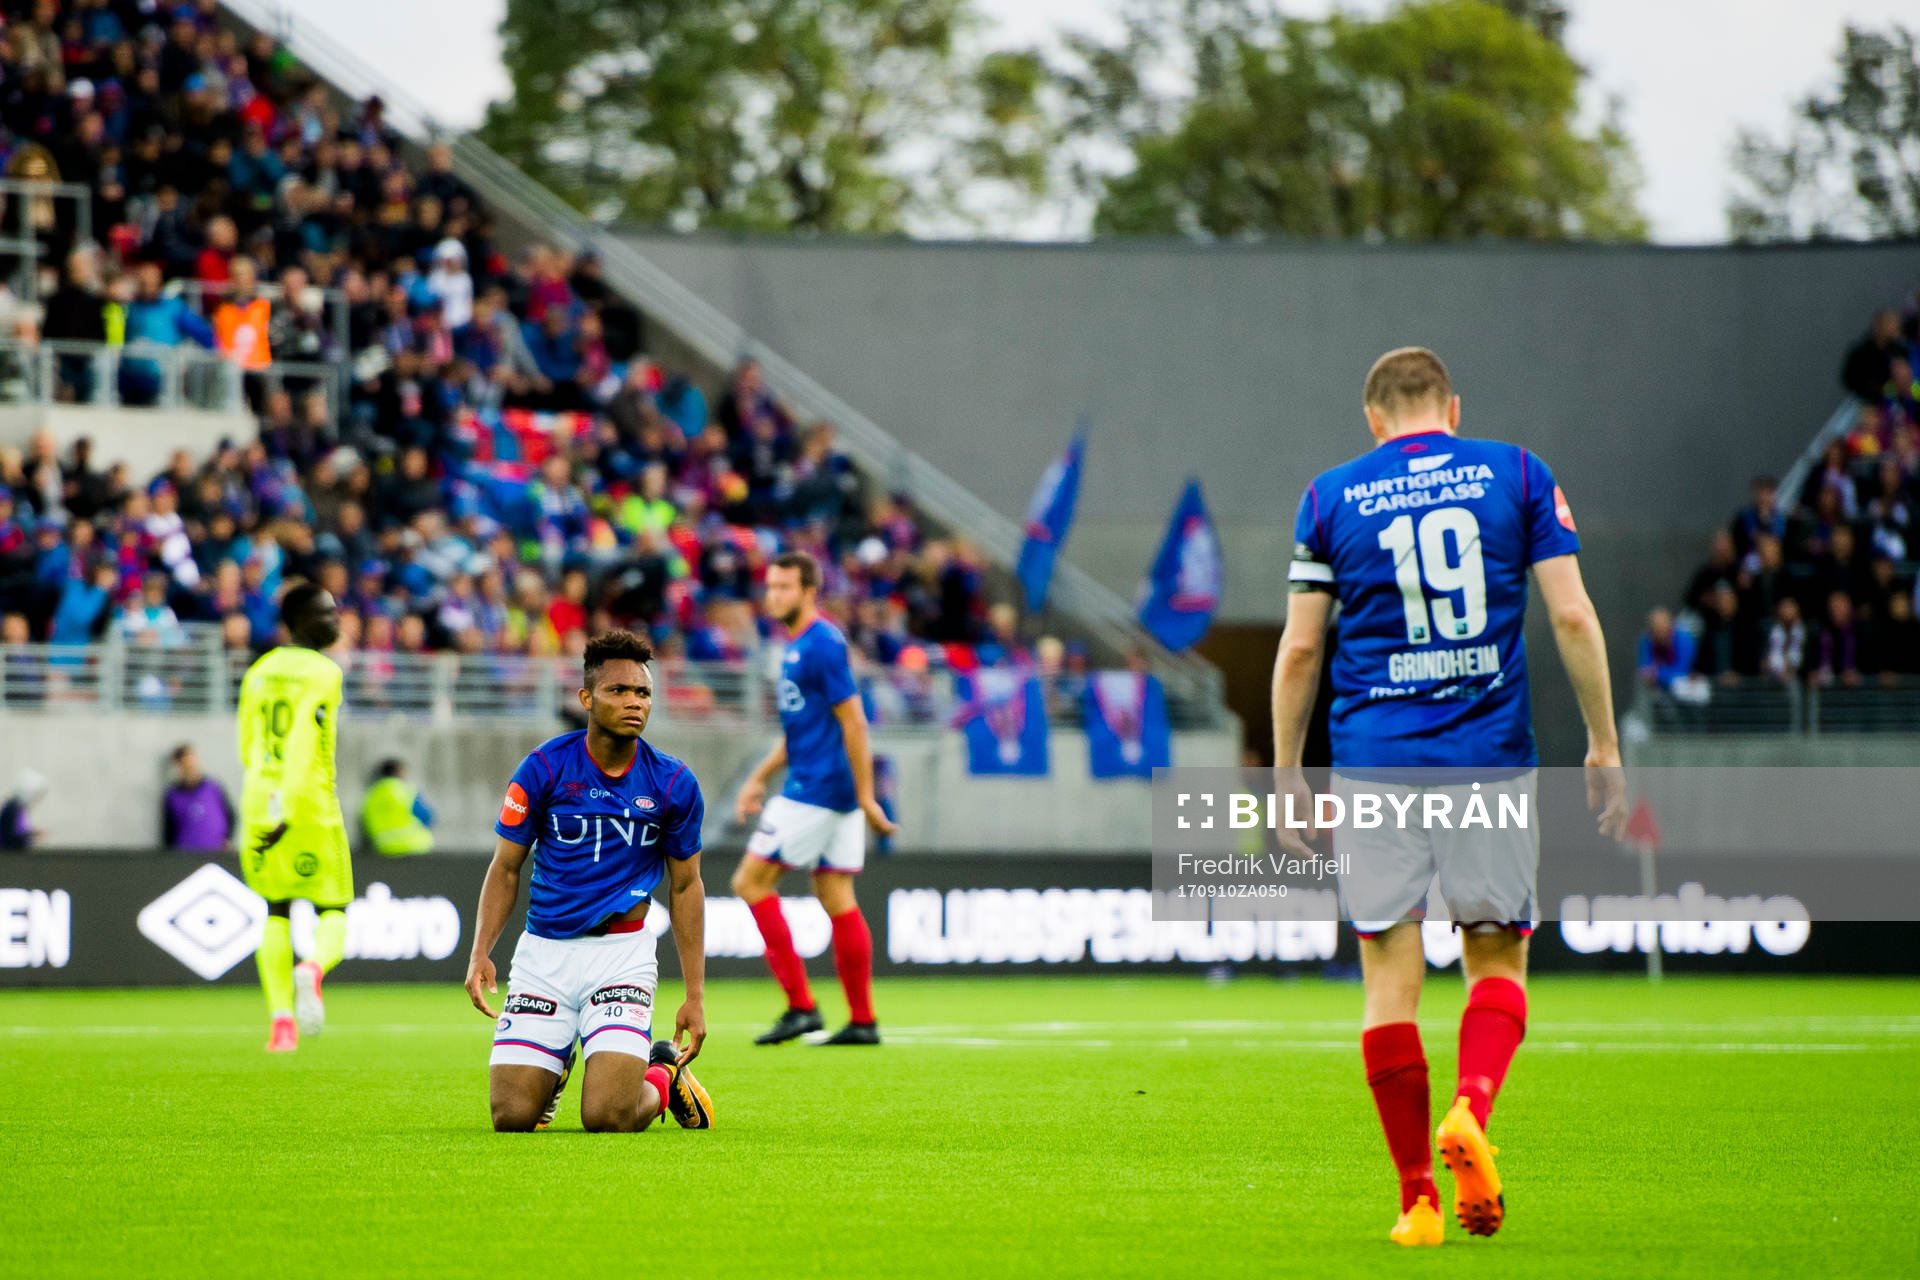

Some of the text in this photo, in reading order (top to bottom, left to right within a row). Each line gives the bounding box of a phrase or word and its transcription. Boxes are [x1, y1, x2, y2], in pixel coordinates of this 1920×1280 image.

[1344, 463, 1495, 503] HURTIGRUTA
[1358, 481, 1486, 517] CARGLASS
[1378, 507, 1488, 645] 19
[1388, 644, 1500, 683] GRINDHEIM
[1560, 881, 1811, 956] umbro
[504, 996, 552, 1013] USEGARD
[604, 1005, 623, 1018] 40
